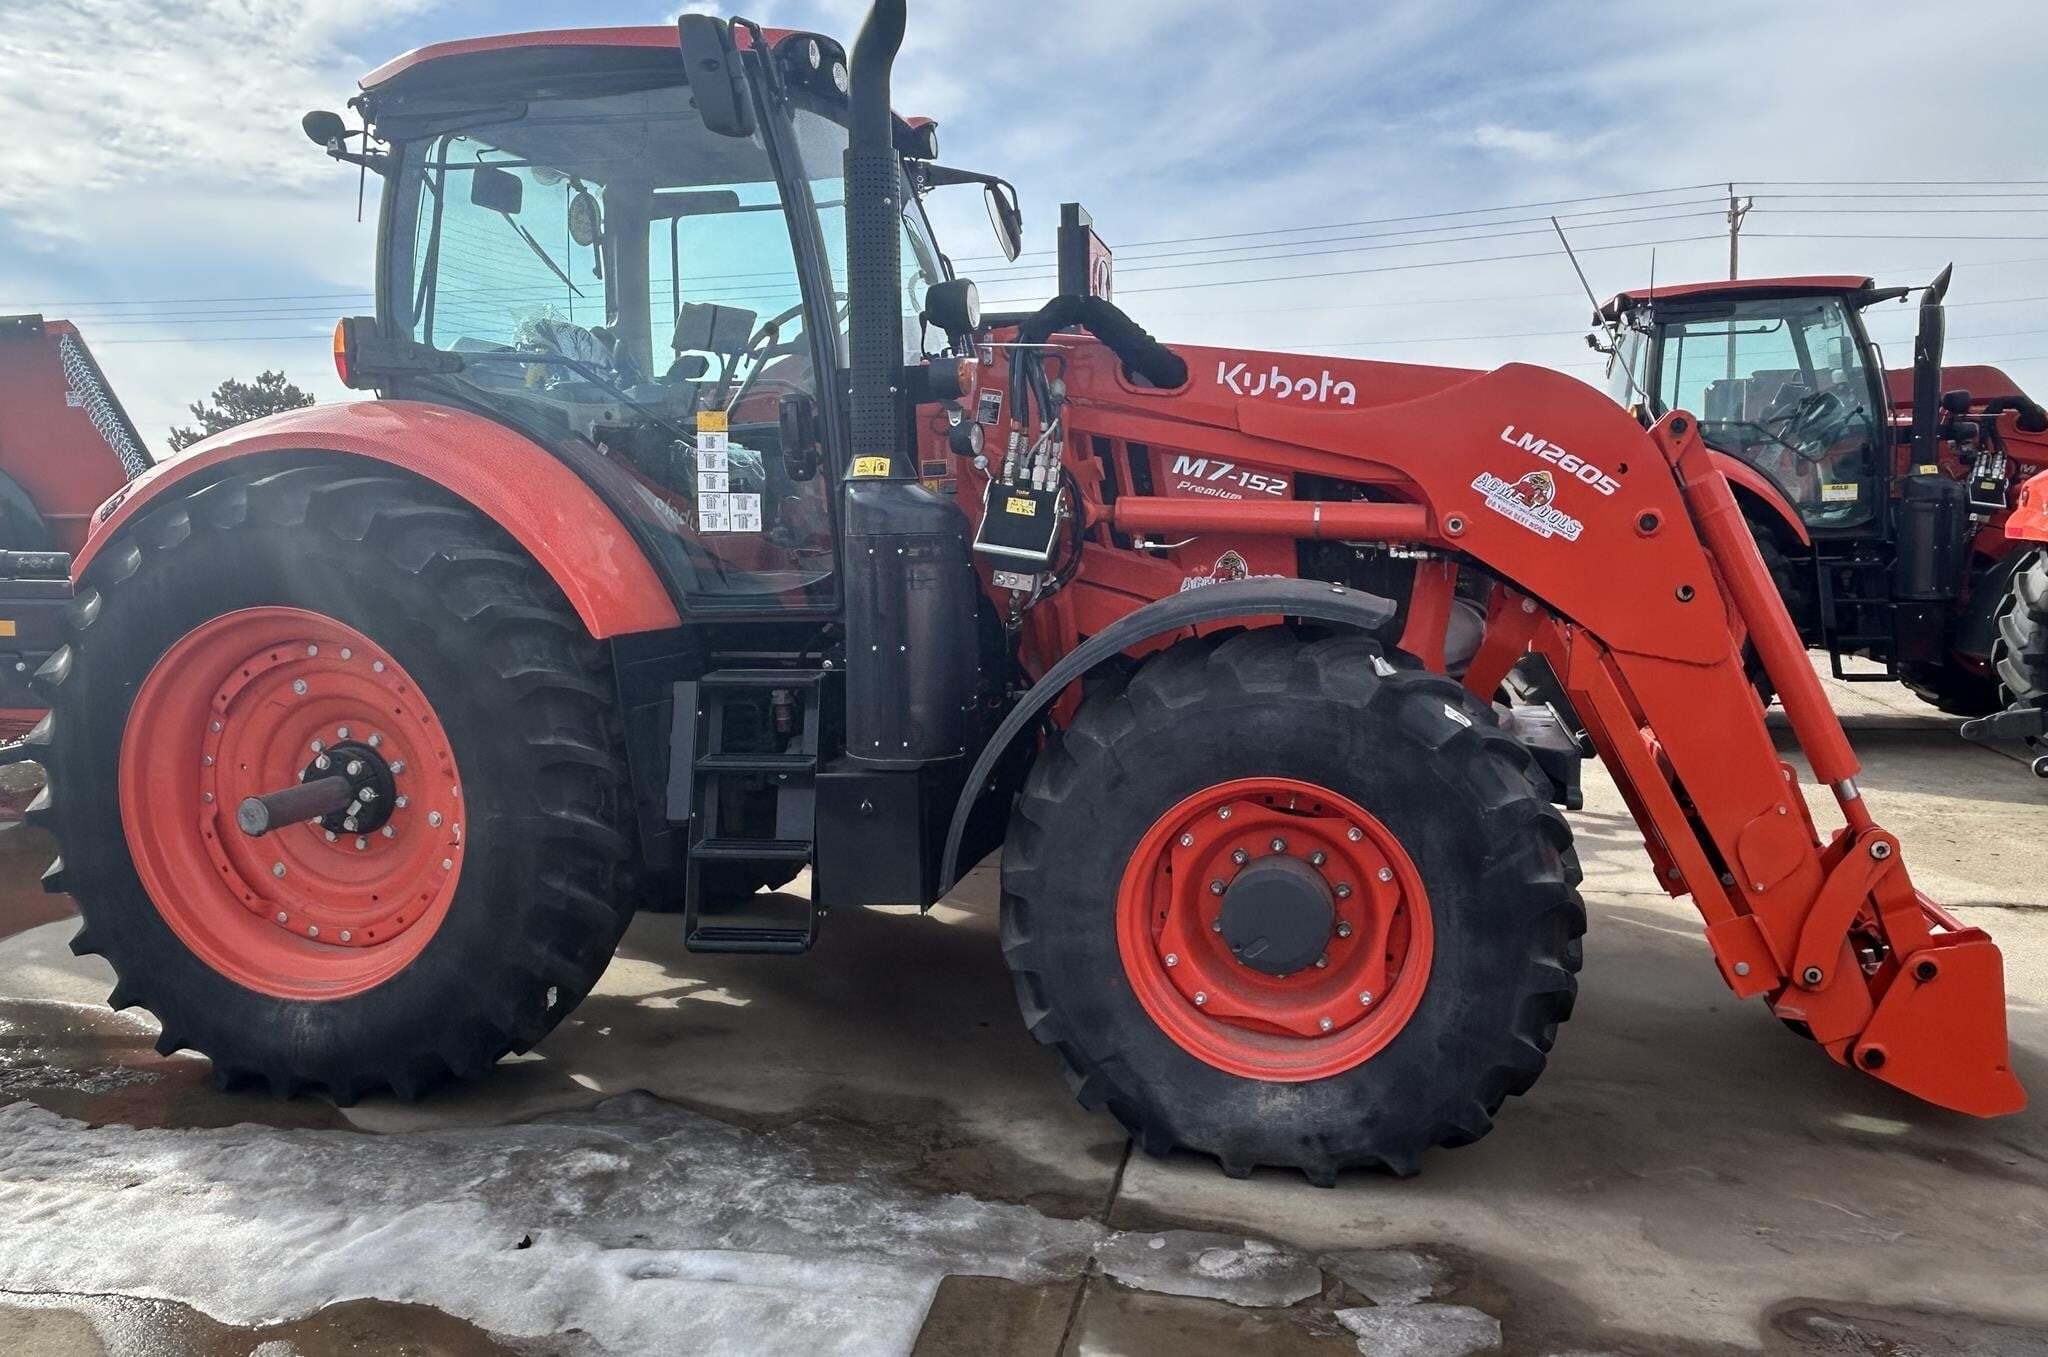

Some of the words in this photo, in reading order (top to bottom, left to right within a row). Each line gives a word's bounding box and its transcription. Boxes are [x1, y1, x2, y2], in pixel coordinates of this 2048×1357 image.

[1216, 361, 1357, 405] Kubota
[1172, 455, 1288, 495] M7-152
[1500, 425, 1621, 496] LM2605
[1177, 480, 1242, 500] Premium
[1475, 473, 1526, 504] ACME
